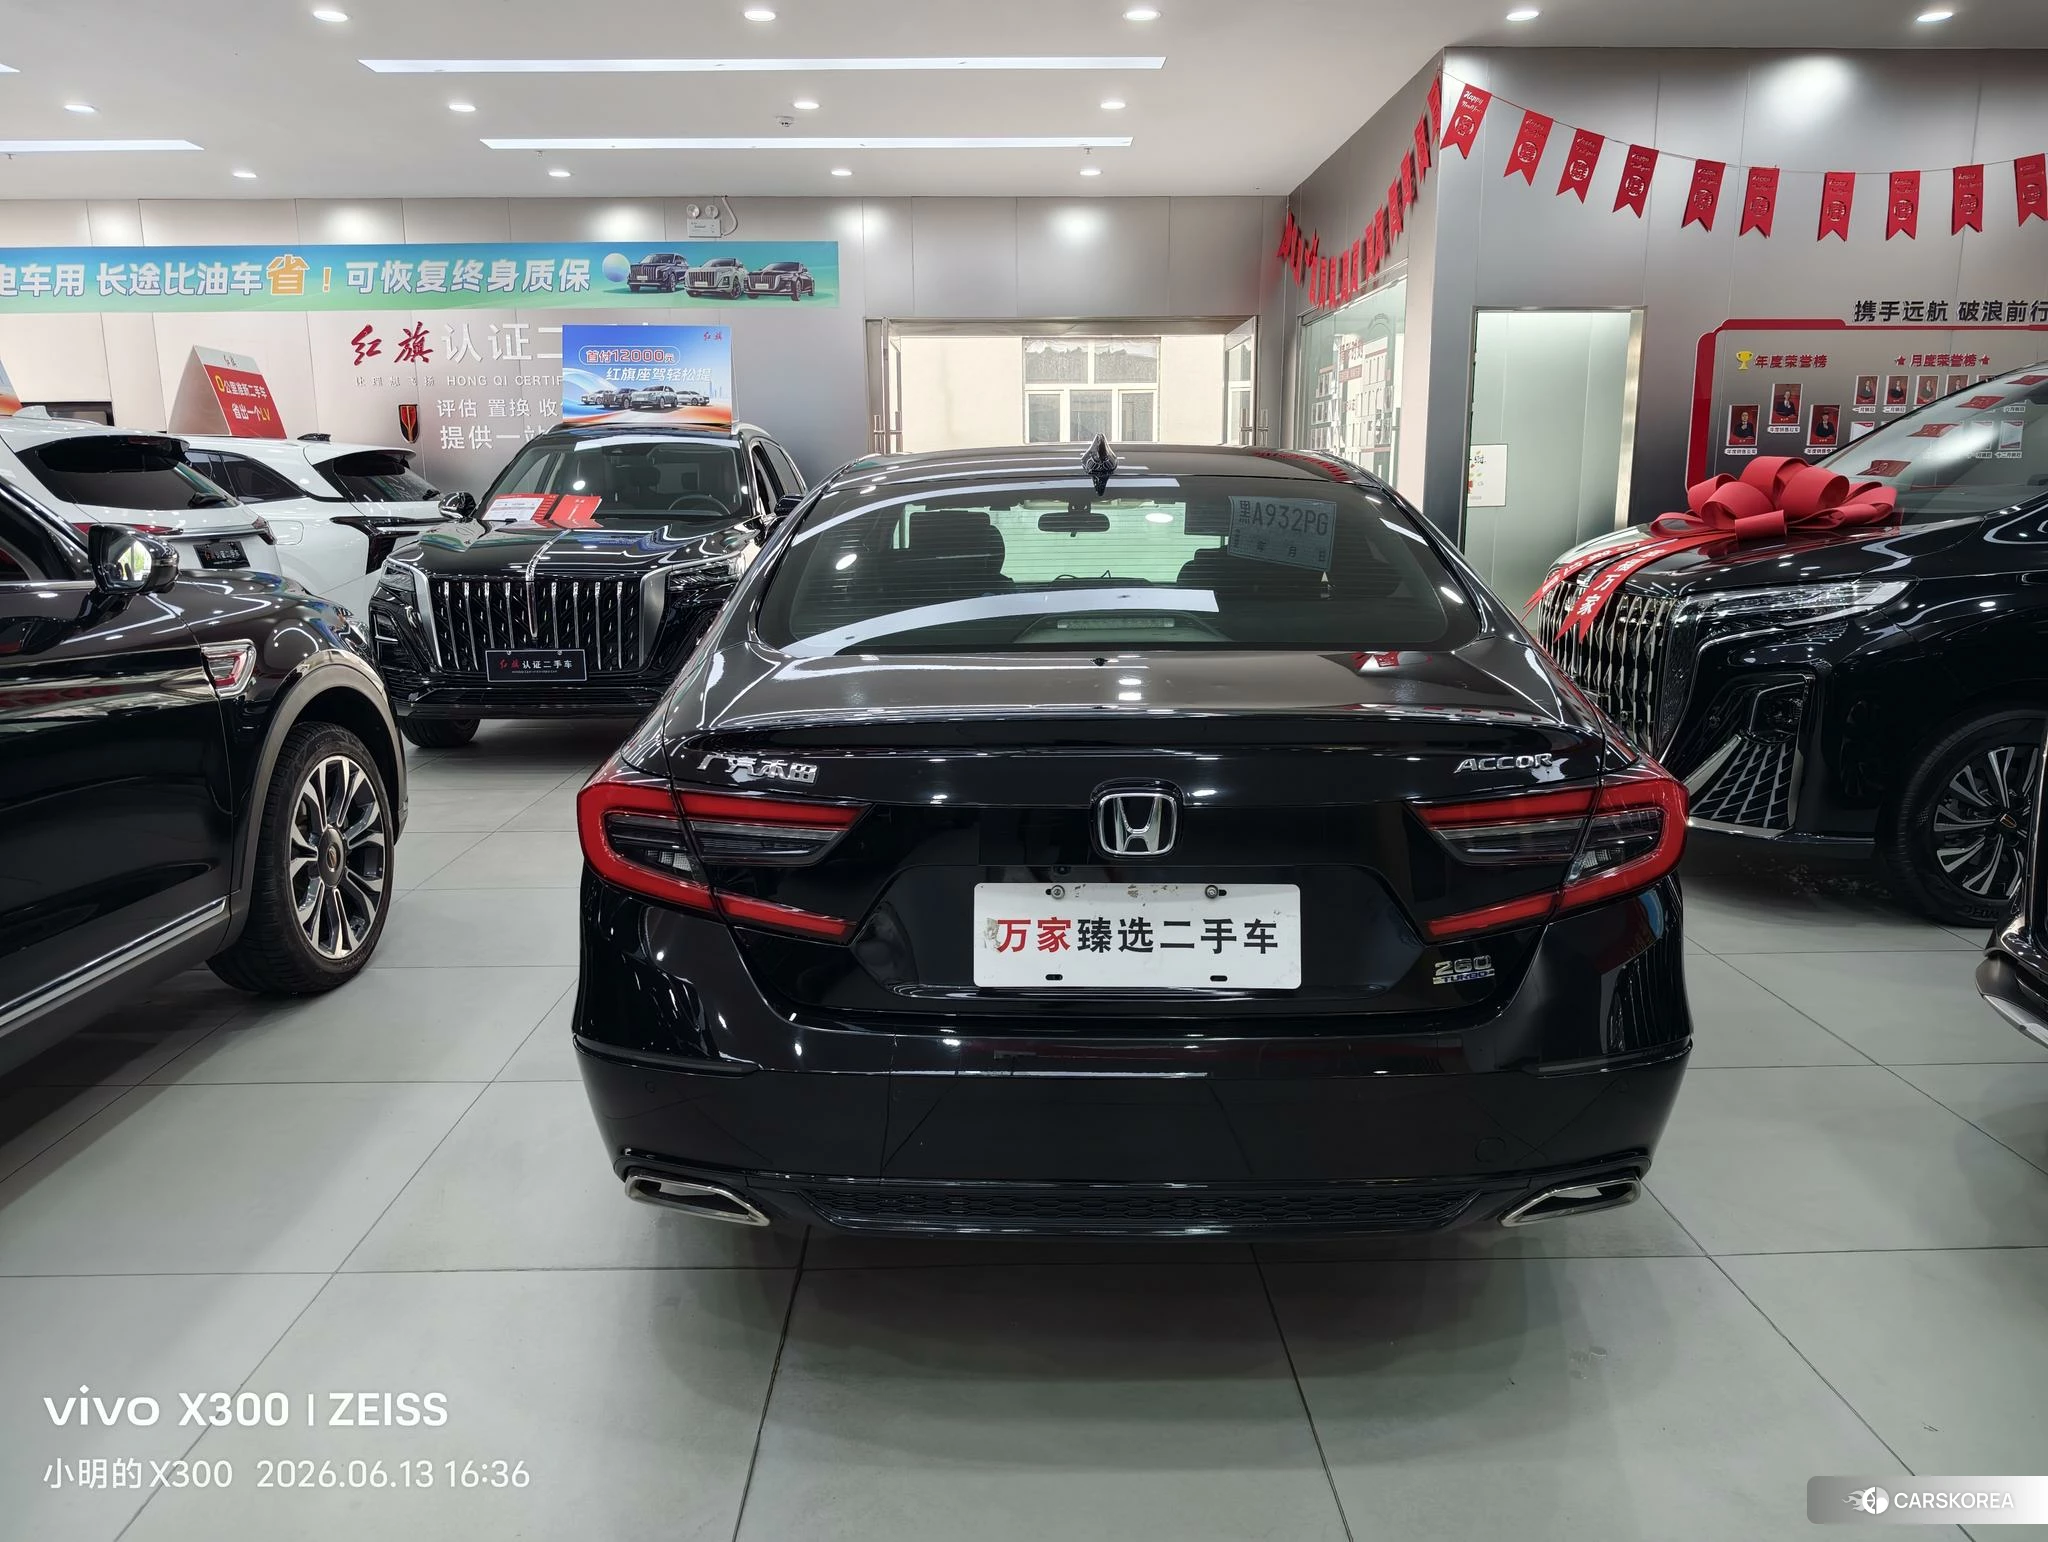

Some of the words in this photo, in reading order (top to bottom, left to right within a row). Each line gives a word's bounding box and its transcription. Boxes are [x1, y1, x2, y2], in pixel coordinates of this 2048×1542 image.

[345, 258, 591, 295] 可恢复终身质保
[1855, 300, 1949, 322] 携手远航
[1958, 300, 2048, 323] 破浪前行
[586, 349, 675, 363] 首付12000元
[1755, 355, 1828, 368] 年度荣誉榜
[1910, 354, 1978, 367] 月度荣誉榜
[447, 375, 488, 386] HONG
[494, 375, 508, 386] QI
[605, 367, 713, 383] 红旗座驾轻松提
[437, 399, 478, 418] 评估
[488, 399, 531, 418] 置换
[539, 399, 563, 418] 收
[1240, 501, 1329, 536] 黑A932PG
[996, 916, 1279, 954] 万家臻选二手车
[1434, 954, 1492, 977] 260
